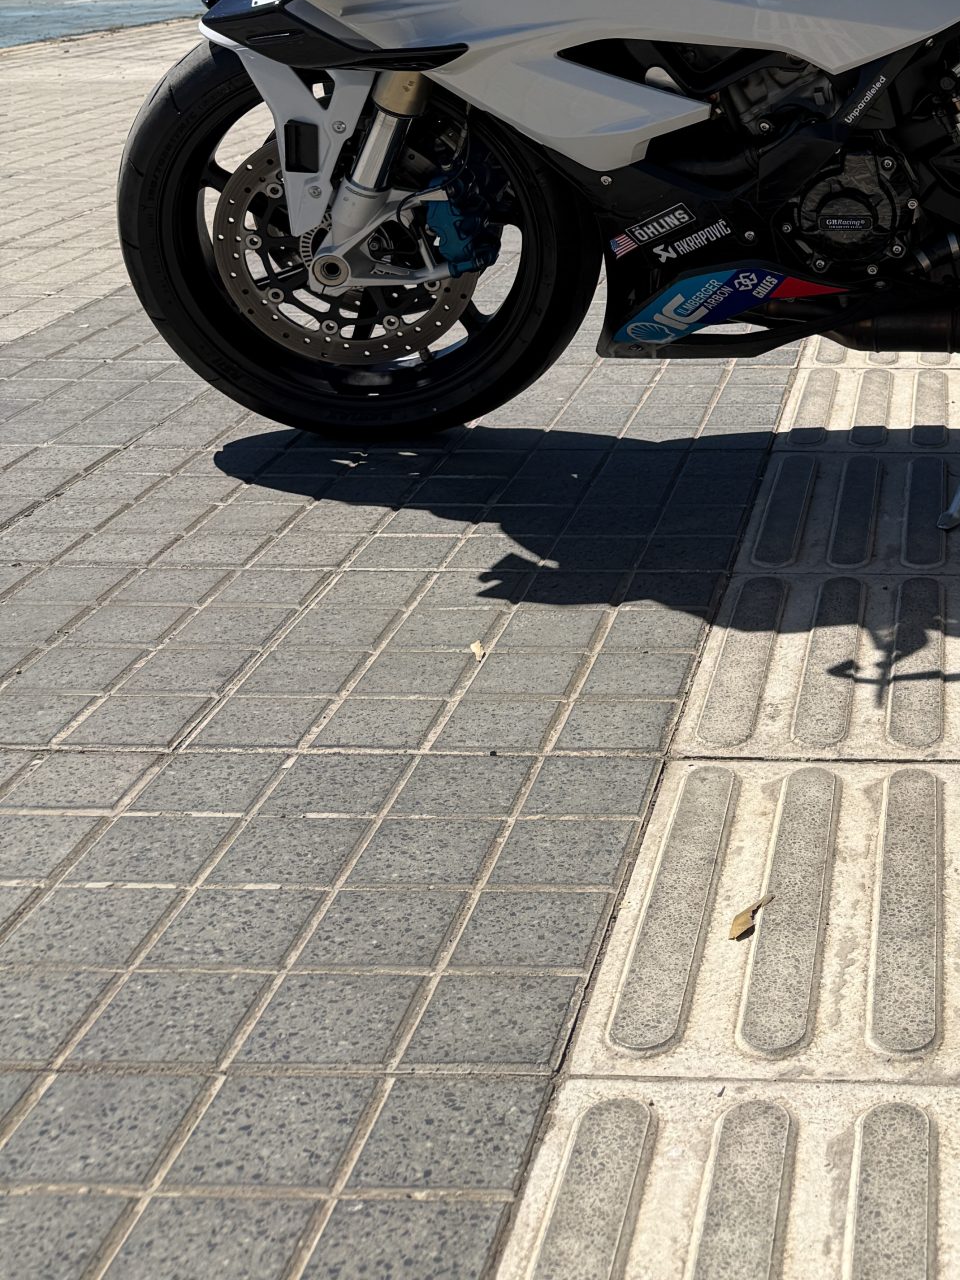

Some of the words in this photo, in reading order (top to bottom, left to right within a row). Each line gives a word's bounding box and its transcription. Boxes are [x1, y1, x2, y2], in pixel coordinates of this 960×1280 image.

[844, 75, 887, 124] Unparalleled
[632, 209, 690, 242] ÖHLINS
[673, 218, 732, 256] AKRAPOVIČ
[677, 279, 724, 315] ILMBERGER
[752, 275, 779, 299] GILLES
